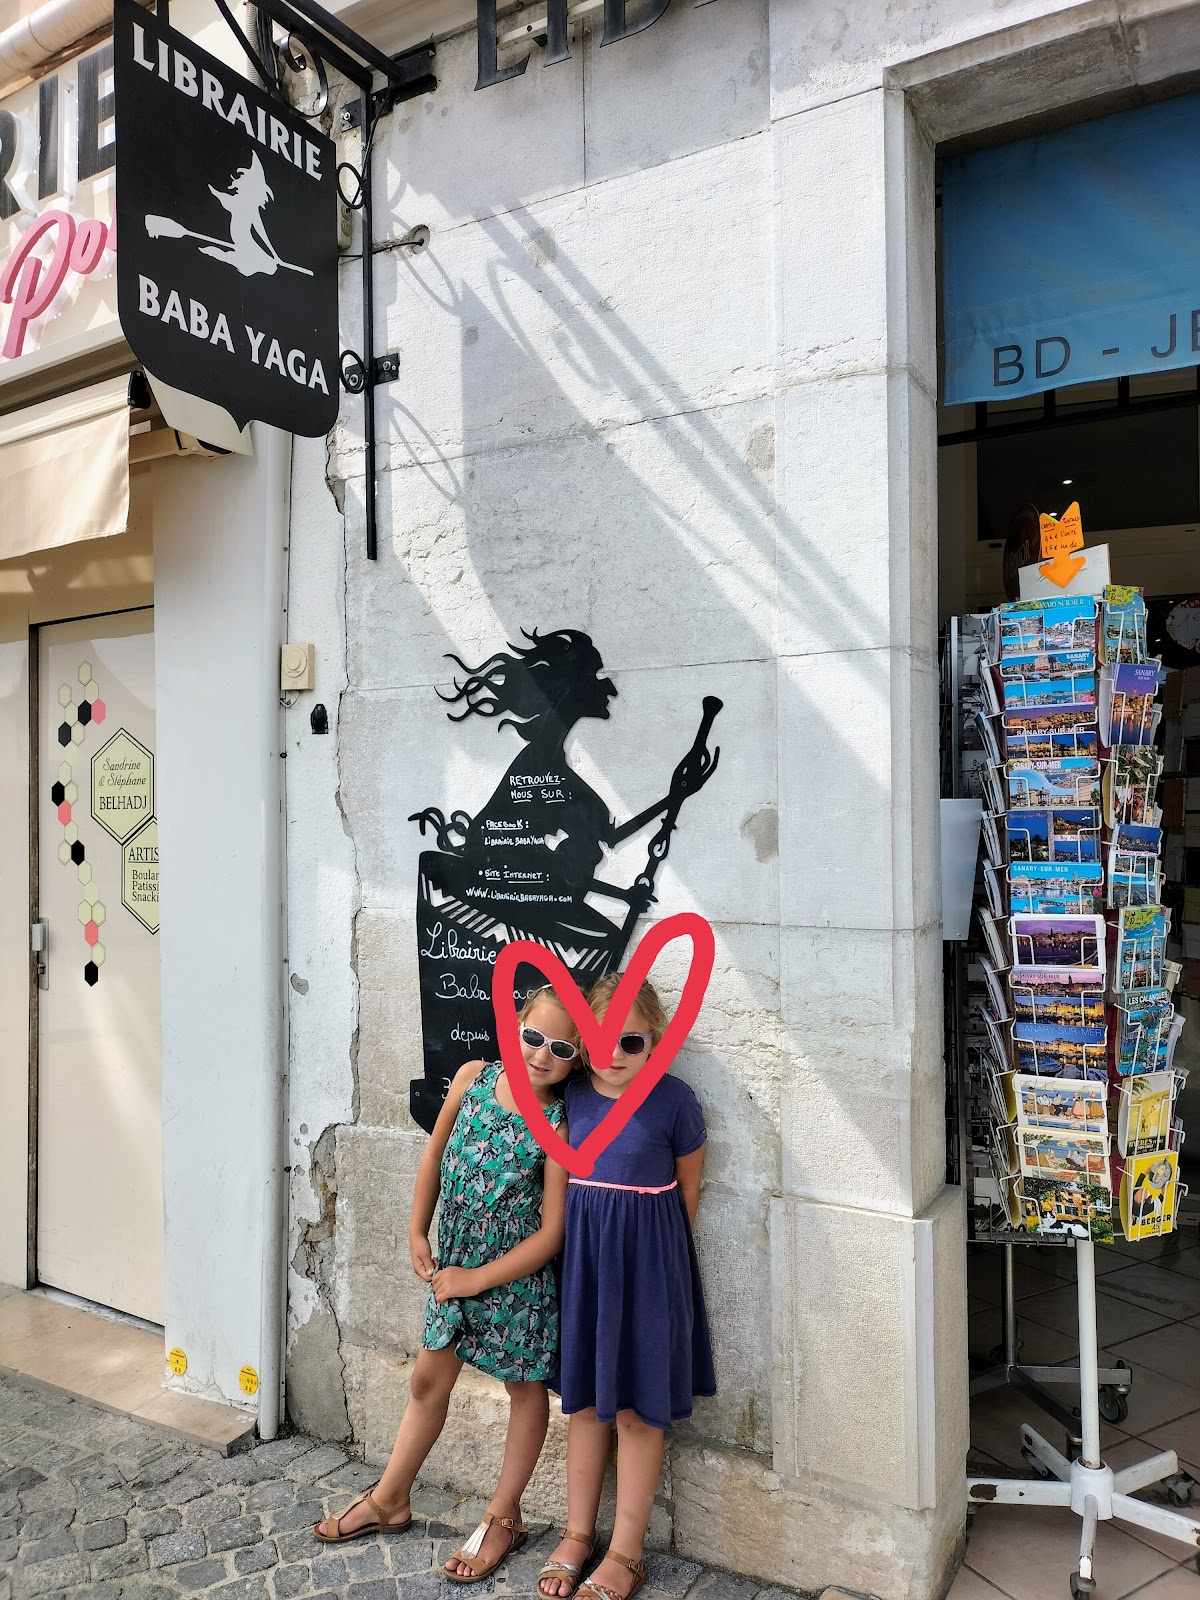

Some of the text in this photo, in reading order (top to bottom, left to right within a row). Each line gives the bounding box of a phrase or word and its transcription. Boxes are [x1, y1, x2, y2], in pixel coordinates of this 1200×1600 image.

[131, 22, 323, 181] LIBRAIRIE
[138, 273, 330, 396] BABA YAGA
[992, 335, 1071, 387] BD
[103, 757, 141, 771] Sandrine
[107, 772, 147, 790] Stéphane
[99, 795, 147, 810] BELHADJ
[510, 790, 533, 800] NOUS
[421, 922, 497, 965] Librairie
[435, 973, 490, 1001] Baba
[451, 1022, 490, 1050] depuis
[1018, 1024, 1102, 1037] SANARY-SUR-MER
[1141, 1213, 1172, 1226] BERGER
